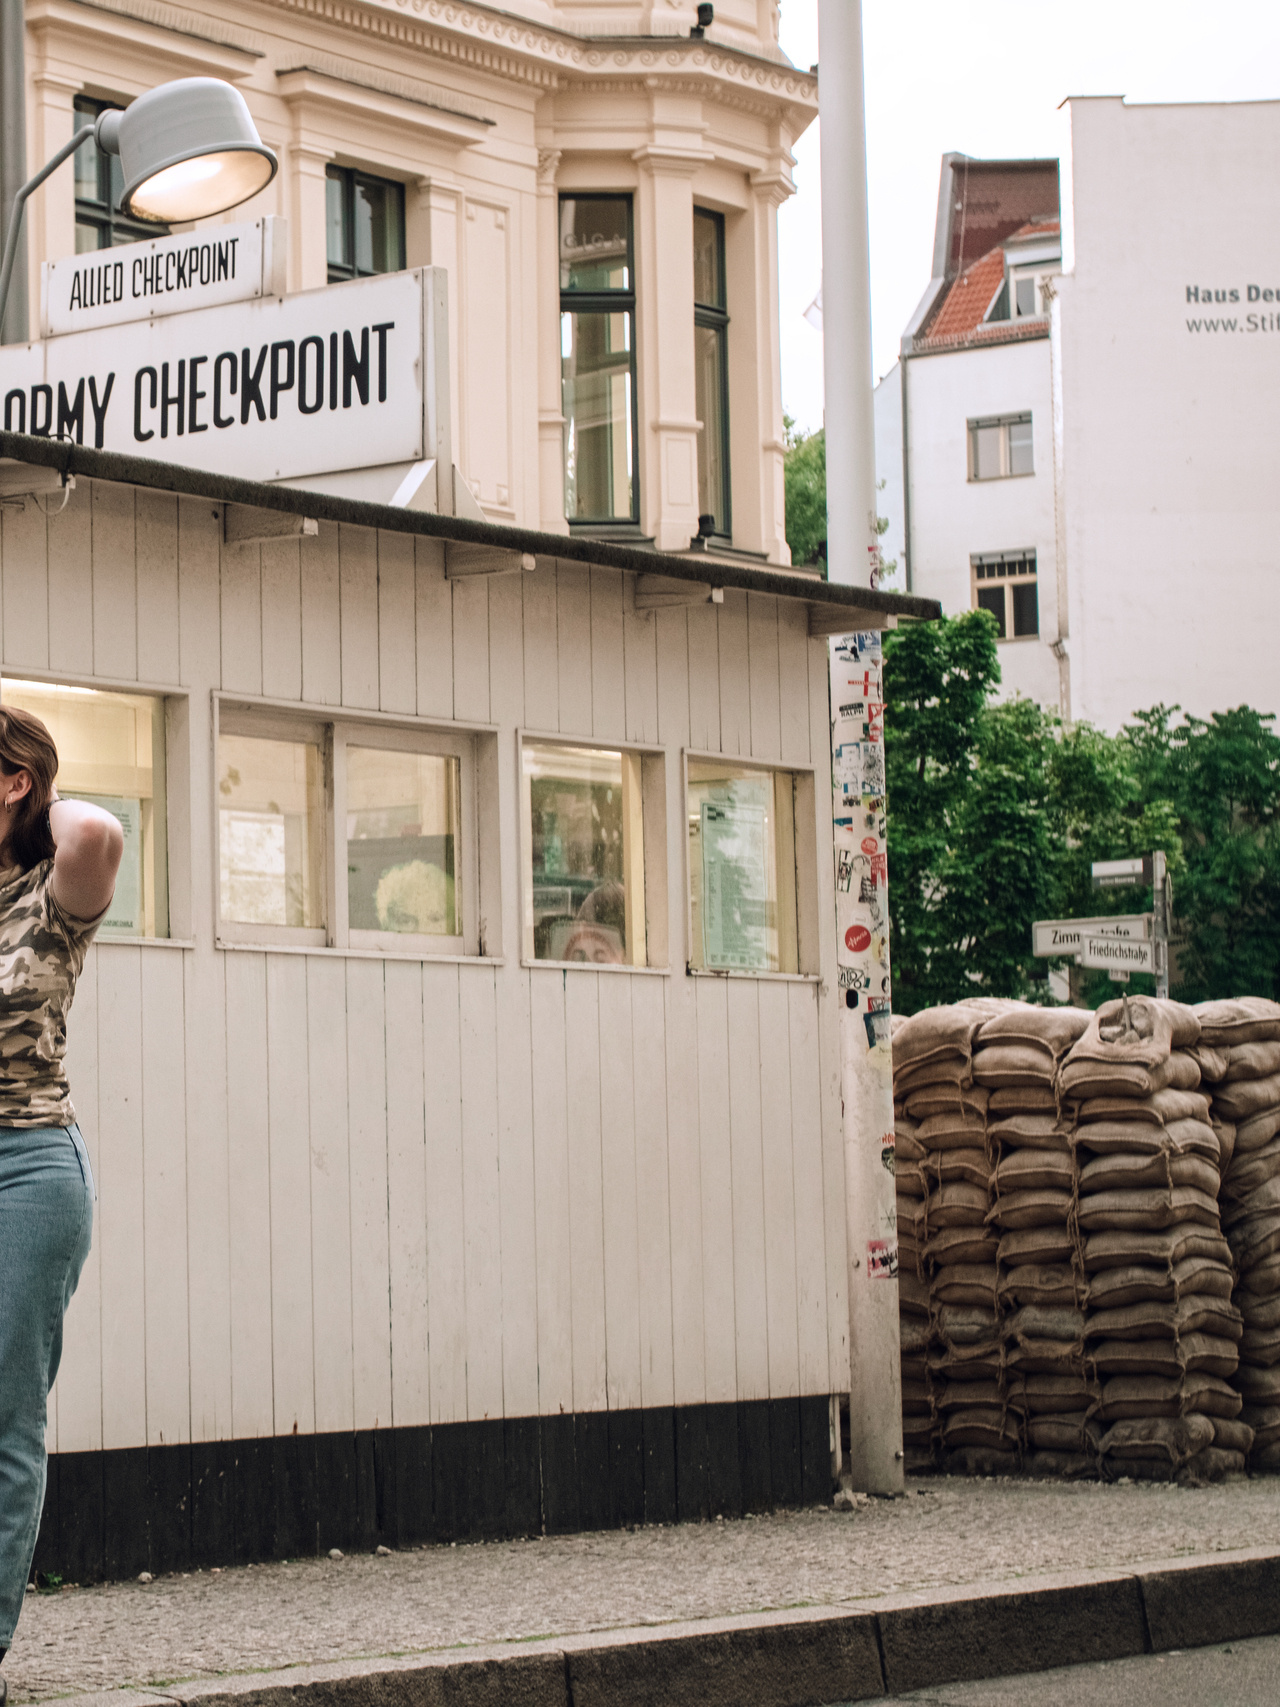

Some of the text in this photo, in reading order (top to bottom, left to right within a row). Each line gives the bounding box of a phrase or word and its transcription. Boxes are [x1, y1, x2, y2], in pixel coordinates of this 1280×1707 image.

[69, 237, 239, 311] ALLIED CHECKPOINT
[1186, 285, 1240, 303] Haus
[133, 321, 395, 443] CHECKPOINT
[1089, 940, 1148, 964] Friedrichstraße
